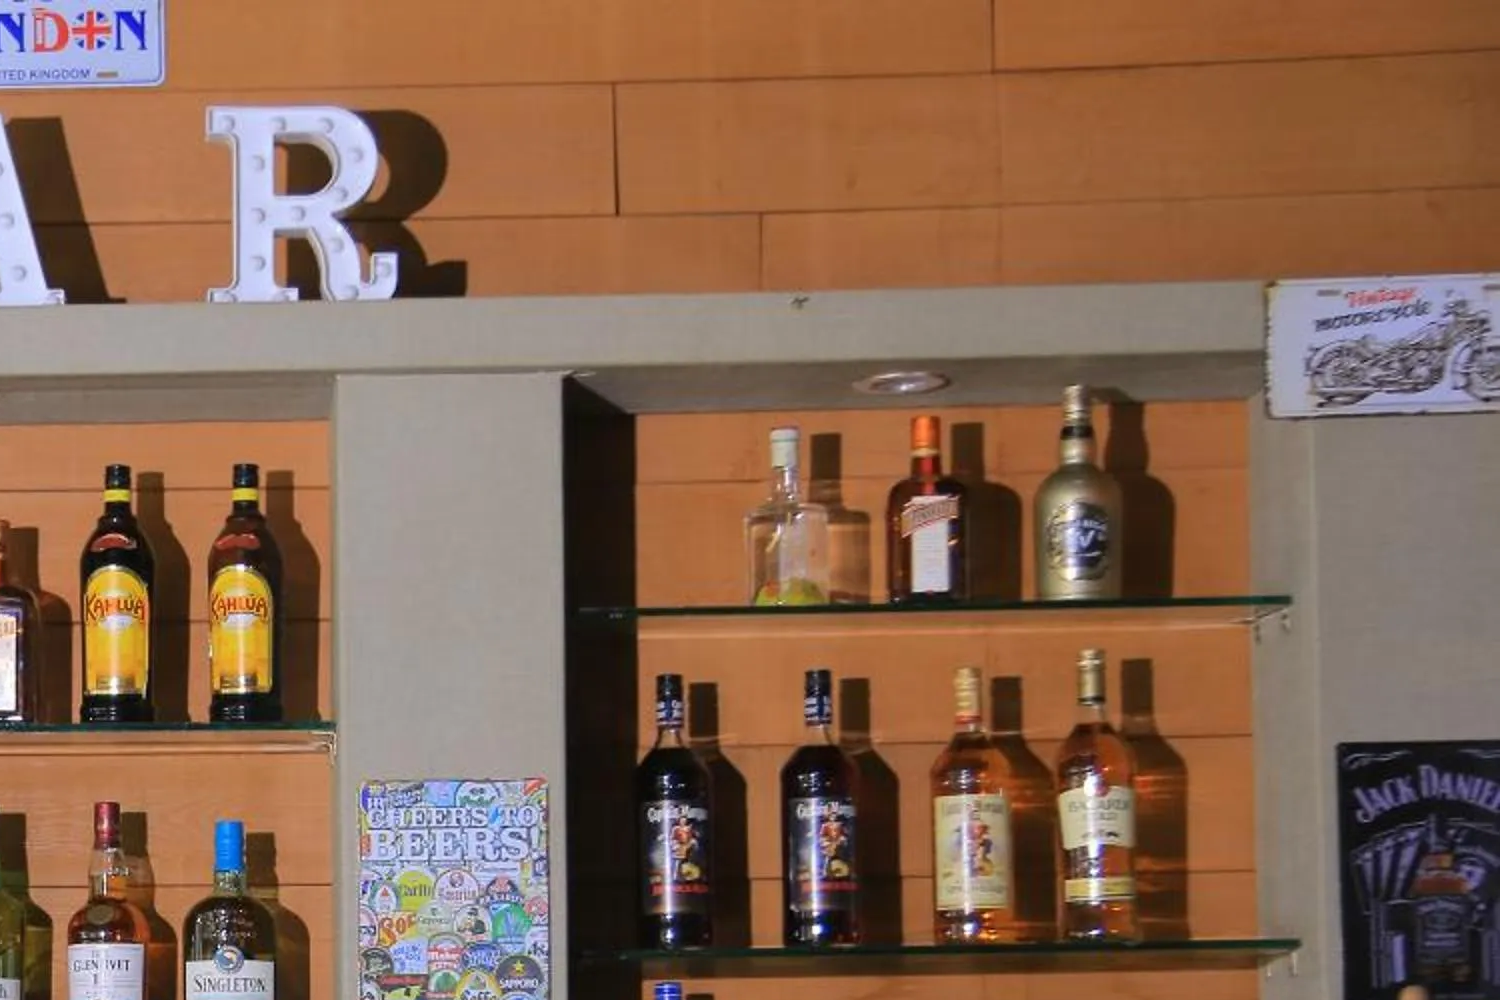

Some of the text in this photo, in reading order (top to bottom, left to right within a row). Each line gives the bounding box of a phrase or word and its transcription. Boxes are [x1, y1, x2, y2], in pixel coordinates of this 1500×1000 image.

[29, 69, 91, 80] KINGDOM
[1353, 775, 1420, 824] JACK
[367, 804, 539, 828] CHEERS TO
[193, 974, 268, 993] SINGLETON
